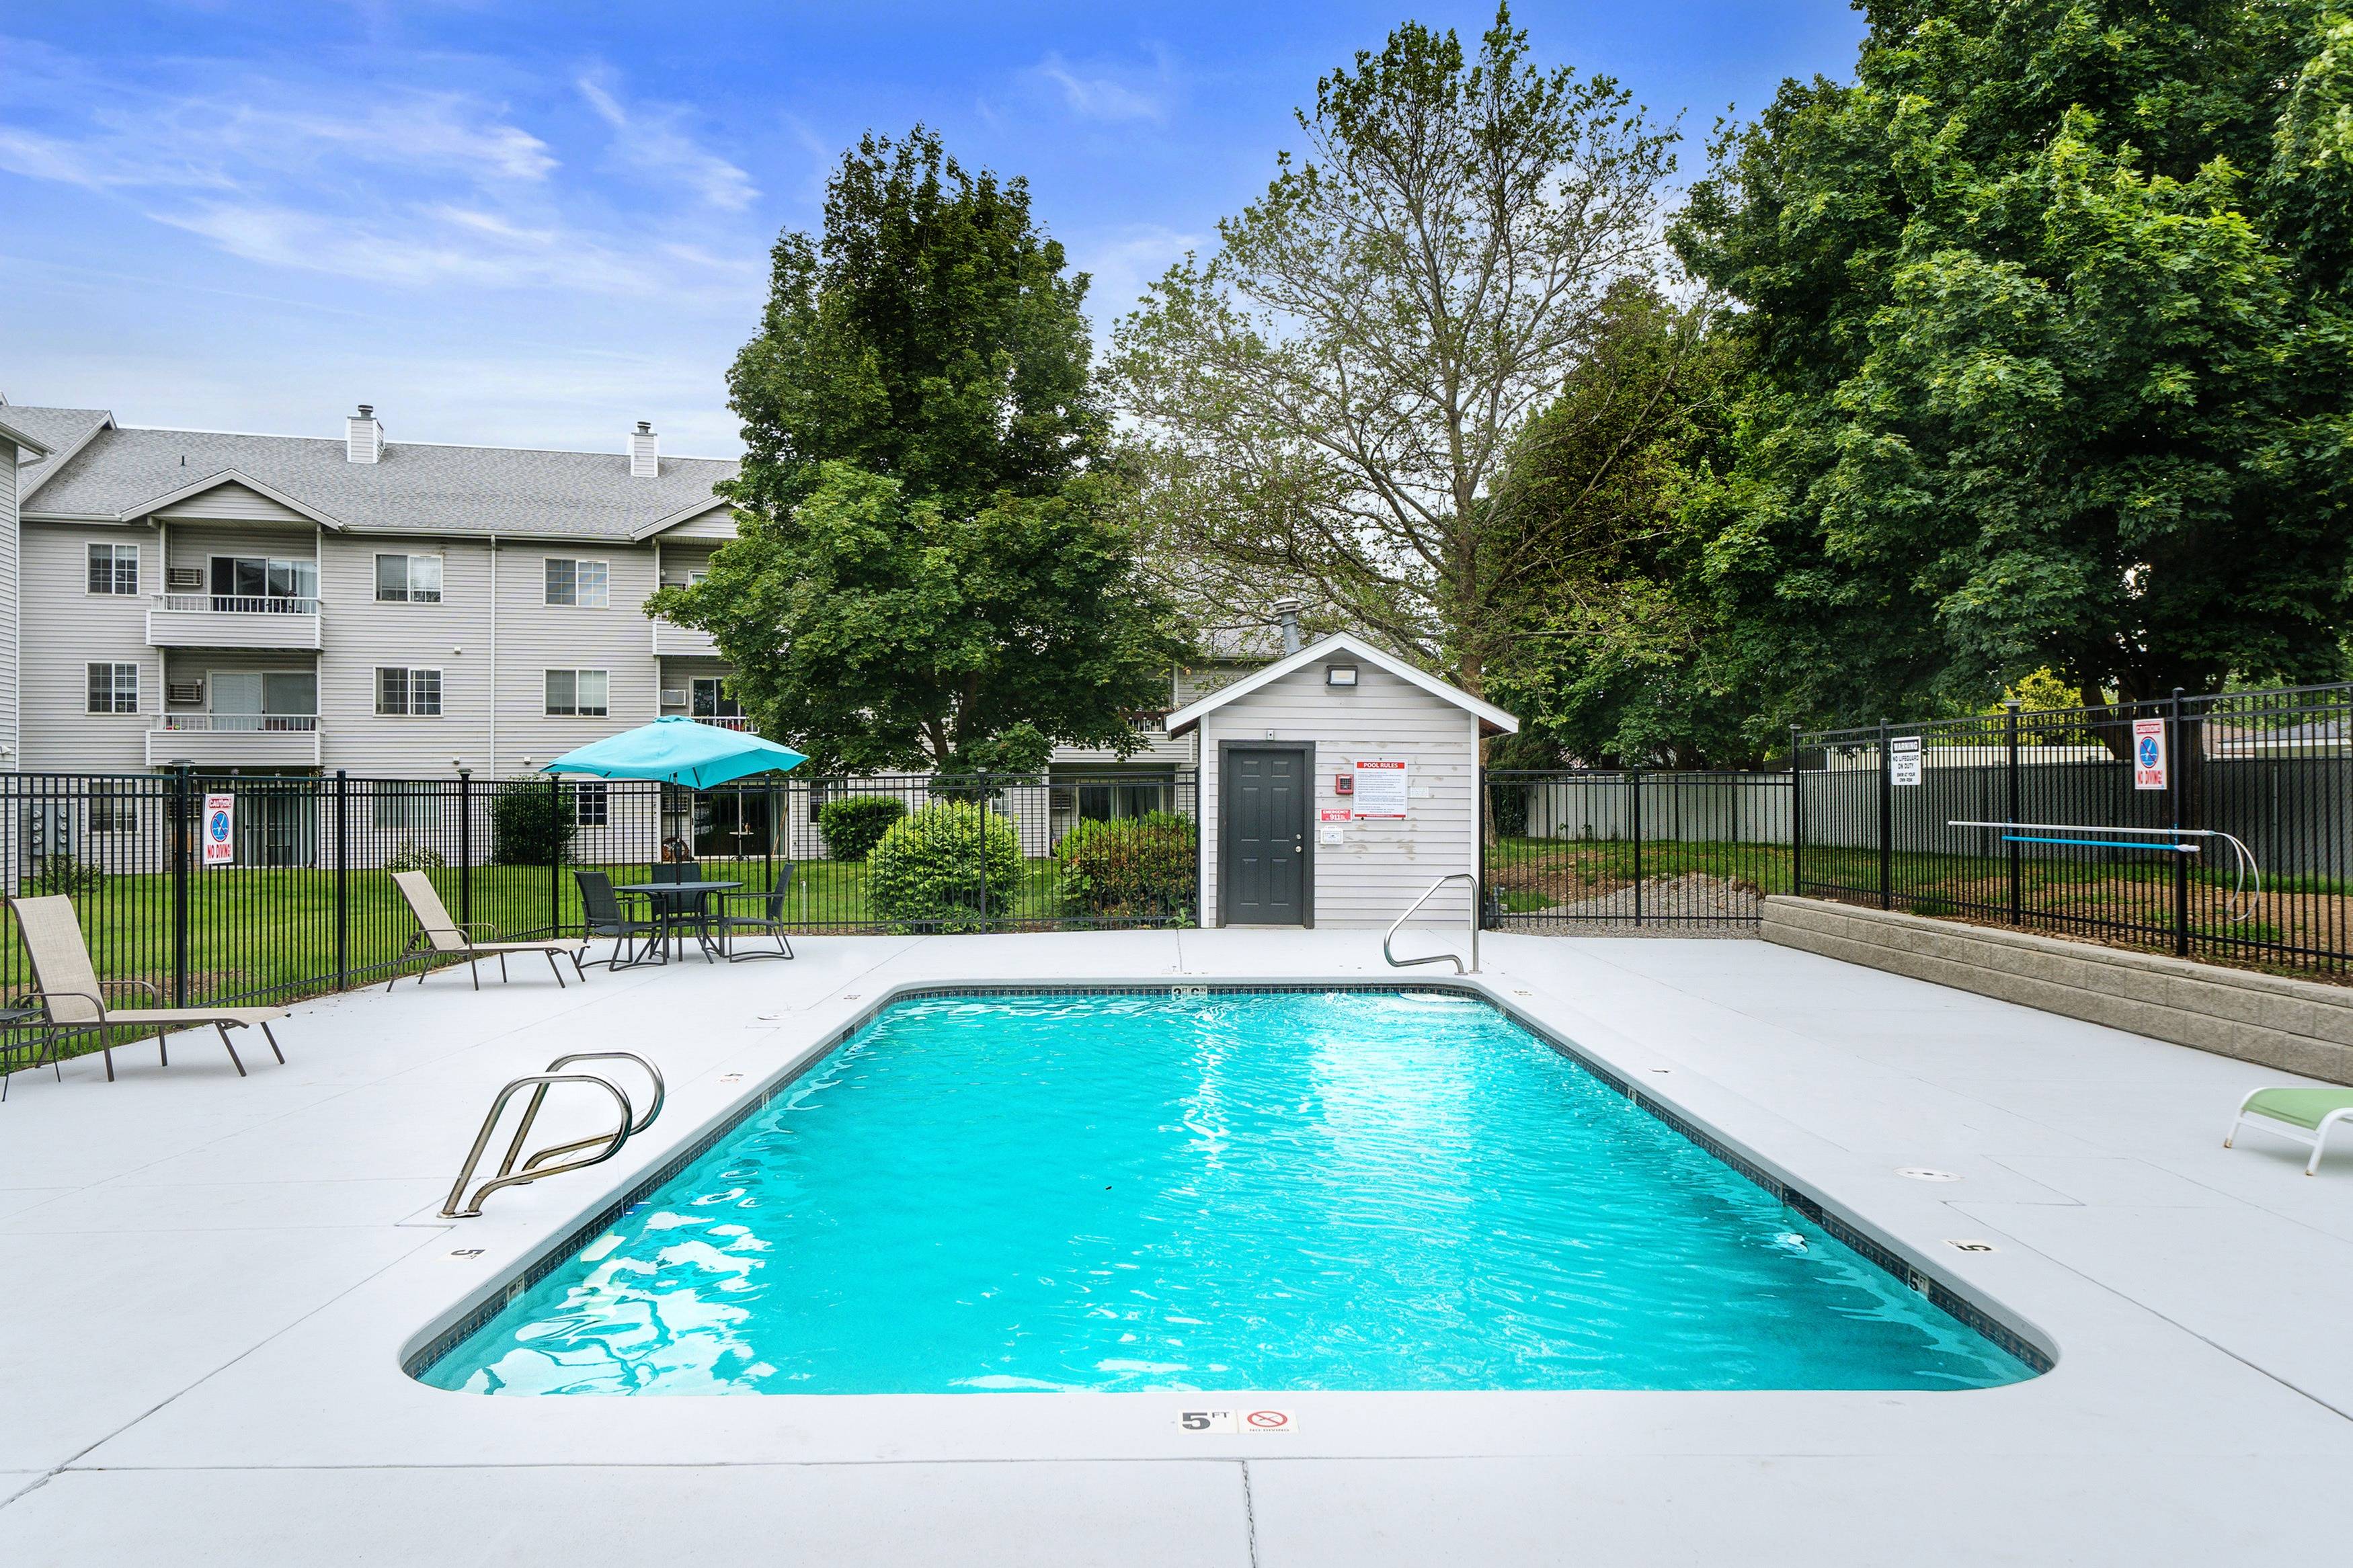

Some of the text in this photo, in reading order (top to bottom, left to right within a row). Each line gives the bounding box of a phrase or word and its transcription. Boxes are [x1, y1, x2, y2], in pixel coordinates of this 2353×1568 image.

[1893, 741, 1918, 751] WARNING
[207, 844, 214, 860] NO
[1909, 1269, 1919, 1292] 5
[1182, 1412, 1211, 1430] 5
